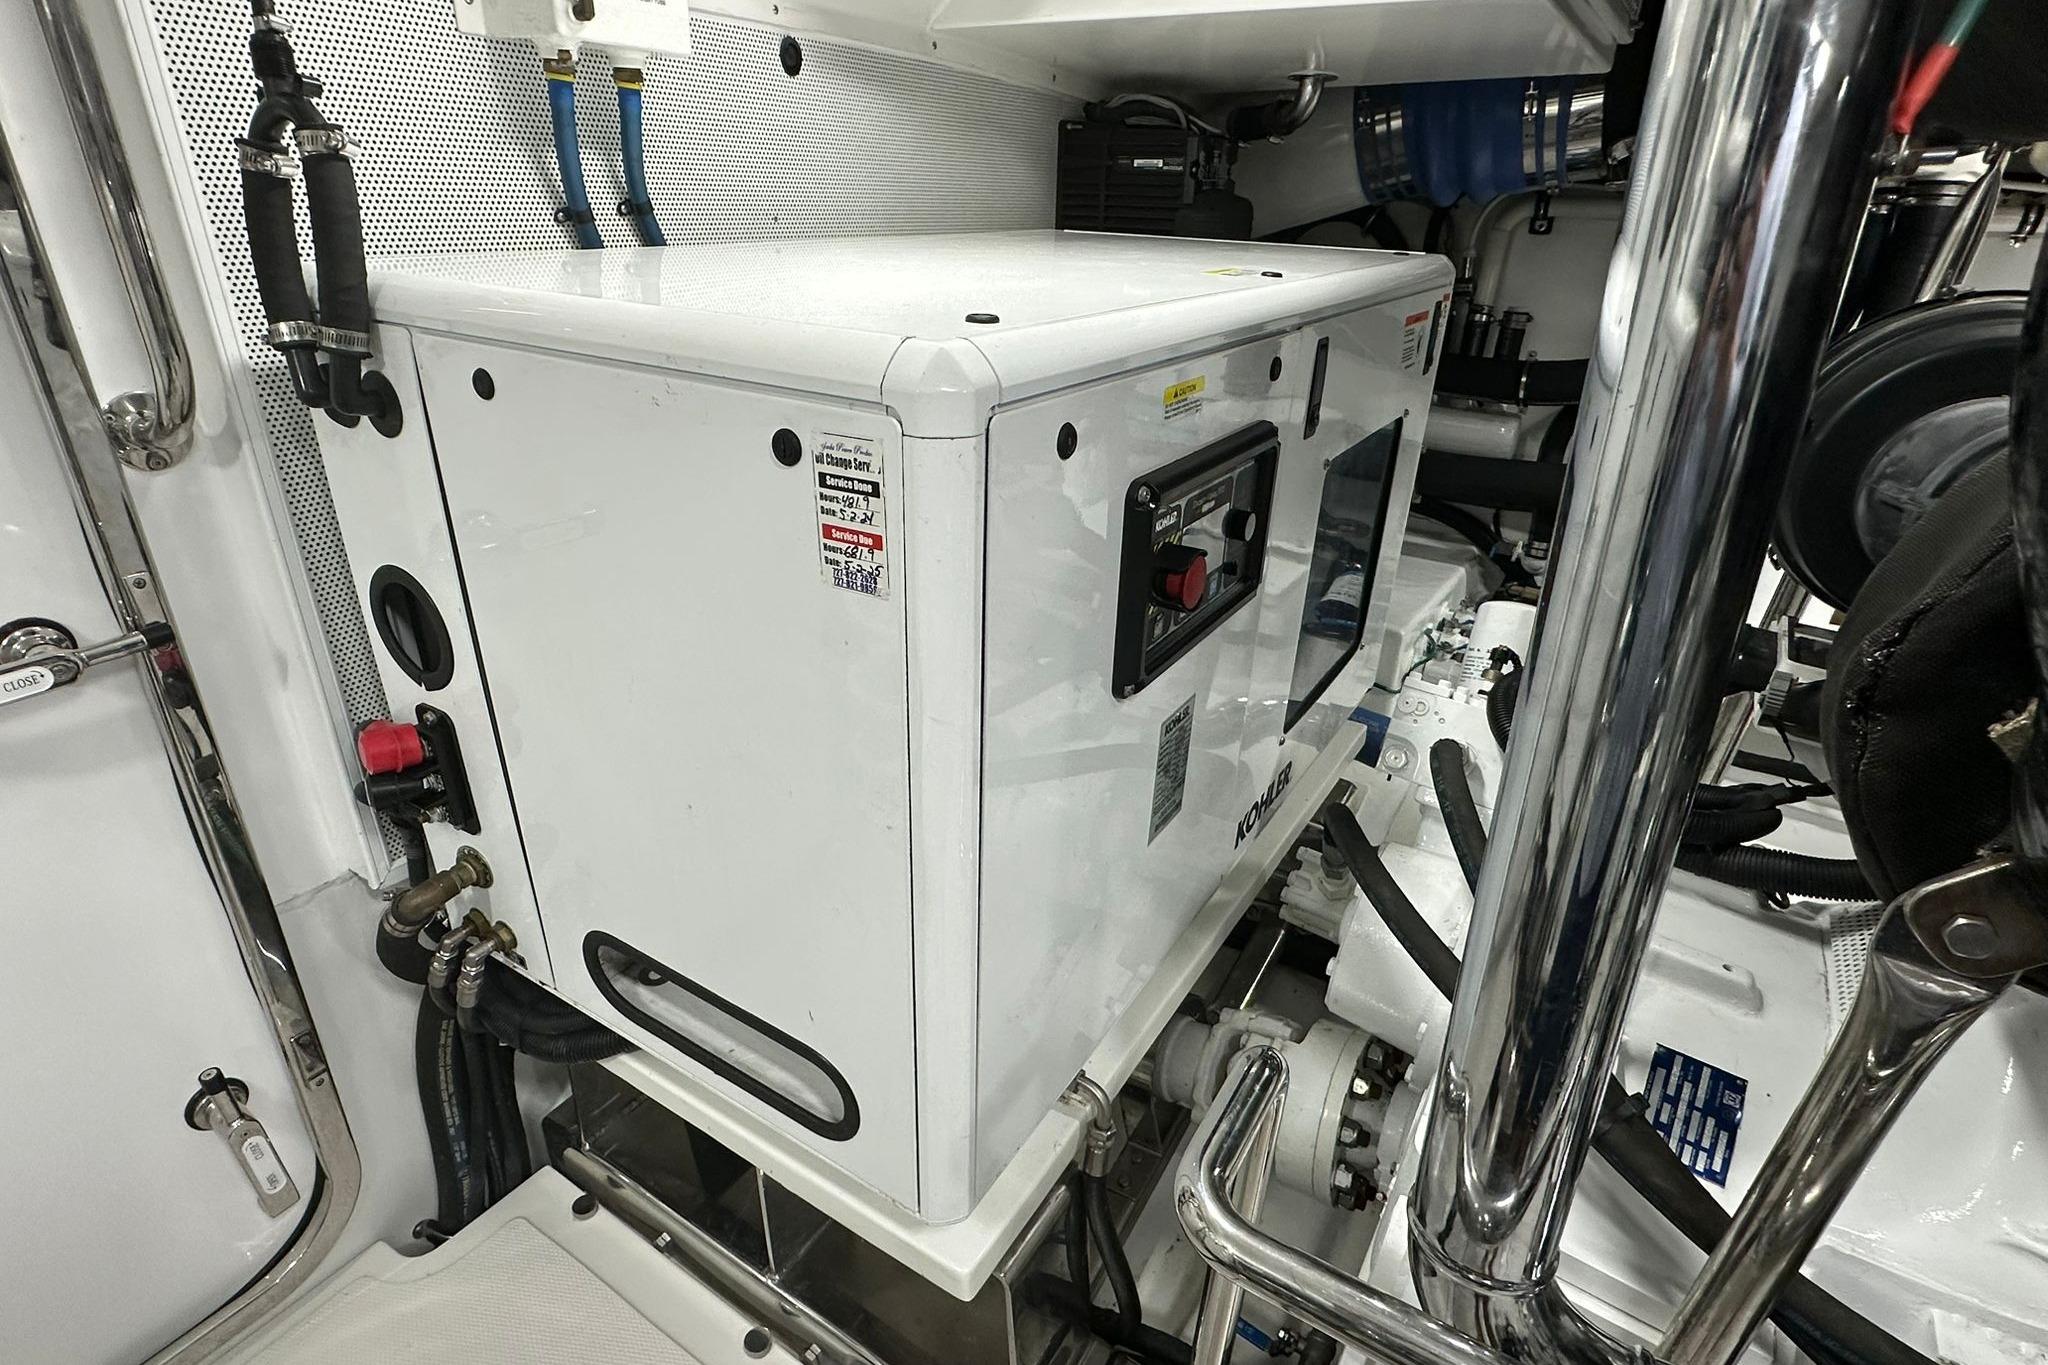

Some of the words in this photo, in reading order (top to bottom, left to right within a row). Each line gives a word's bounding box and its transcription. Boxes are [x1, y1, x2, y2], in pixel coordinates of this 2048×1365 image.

[826, 453, 853, 470] Change
[826, 475, 853, 489] Service
[854, 480, 873, 493] Done
[831, 528, 858, 543] Service
[859, 534, 874, 546] Due
[3, 674, 40, 692] CLOSE
[1234, 760, 1293, 850] KOHLER
